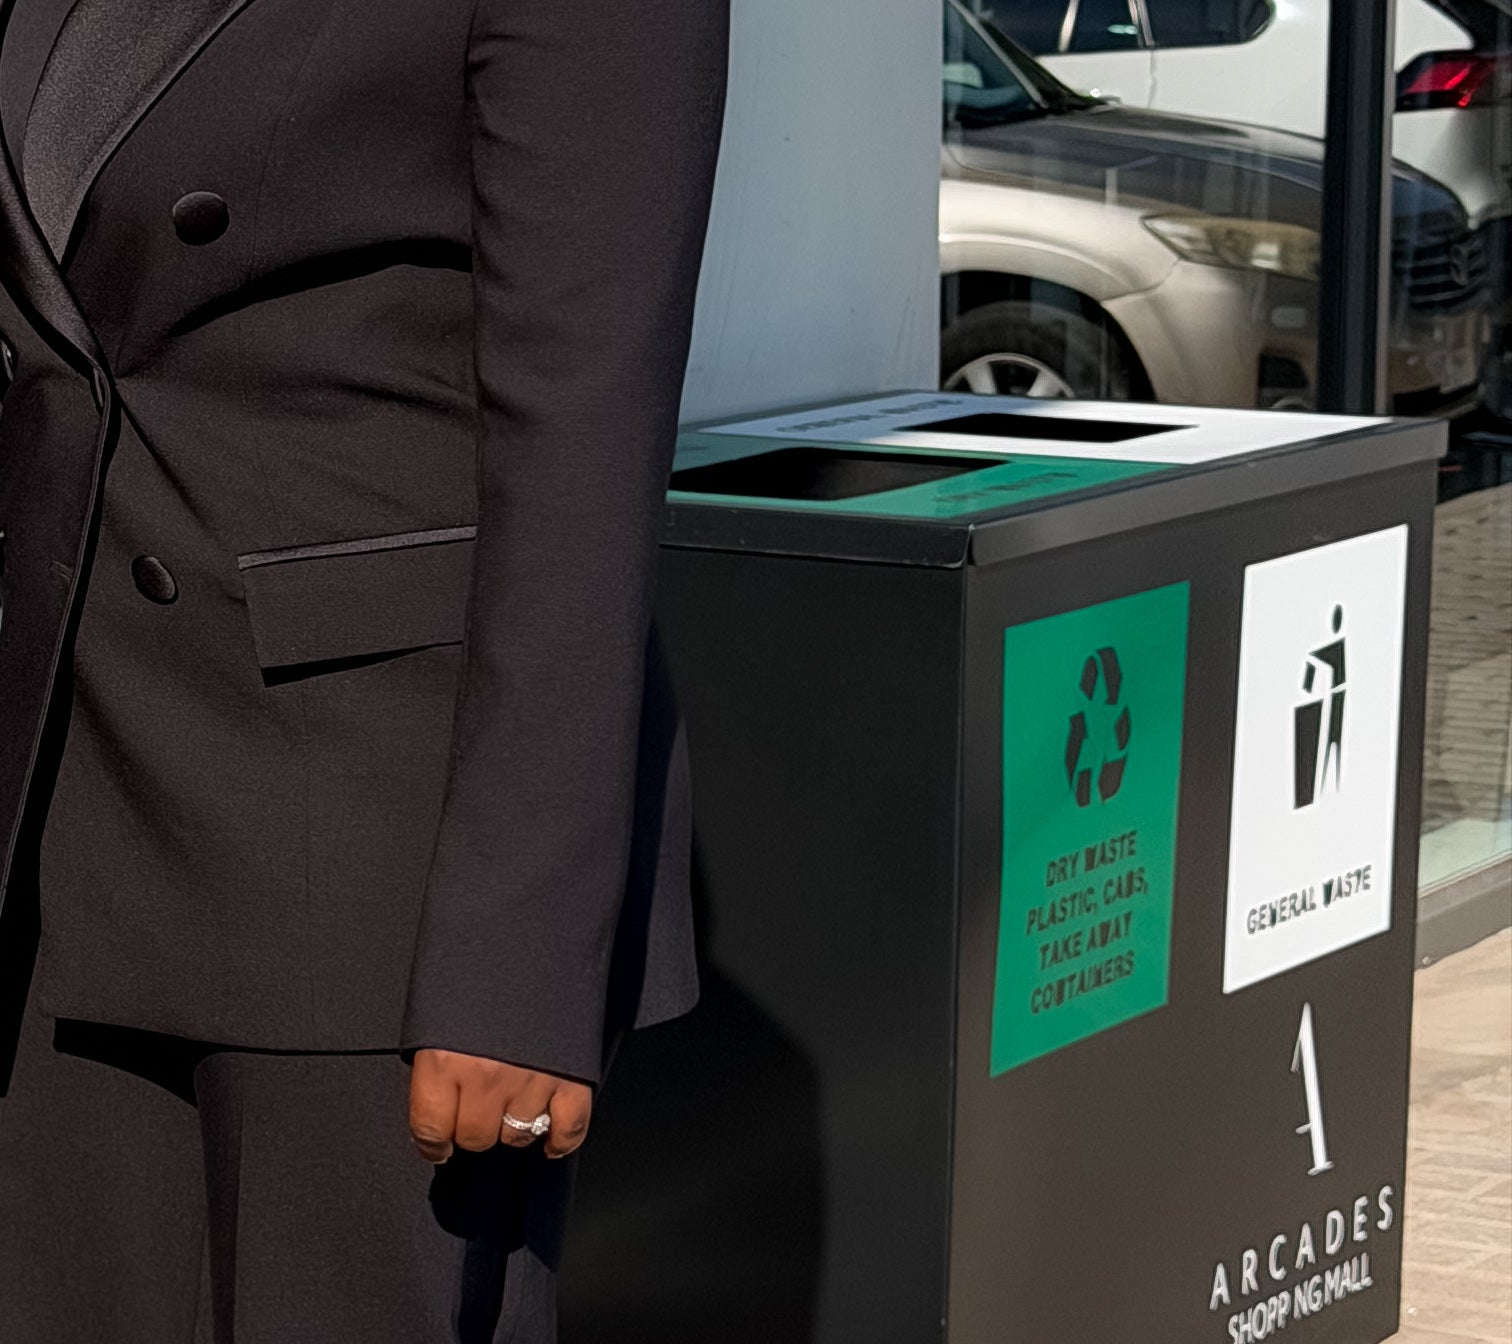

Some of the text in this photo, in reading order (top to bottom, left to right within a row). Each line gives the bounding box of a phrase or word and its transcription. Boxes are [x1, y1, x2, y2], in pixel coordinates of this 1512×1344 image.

[1046, 830, 1138, 888] DRY WASTE
[1026, 887, 1098, 936] PLASTIC,
[1246, 864, 1372, 934] GENERAL WASTE
[1040, 911, 1133, 971] TAKE AWAY
[1209, 1185, 1394, 1310] ARCADES
